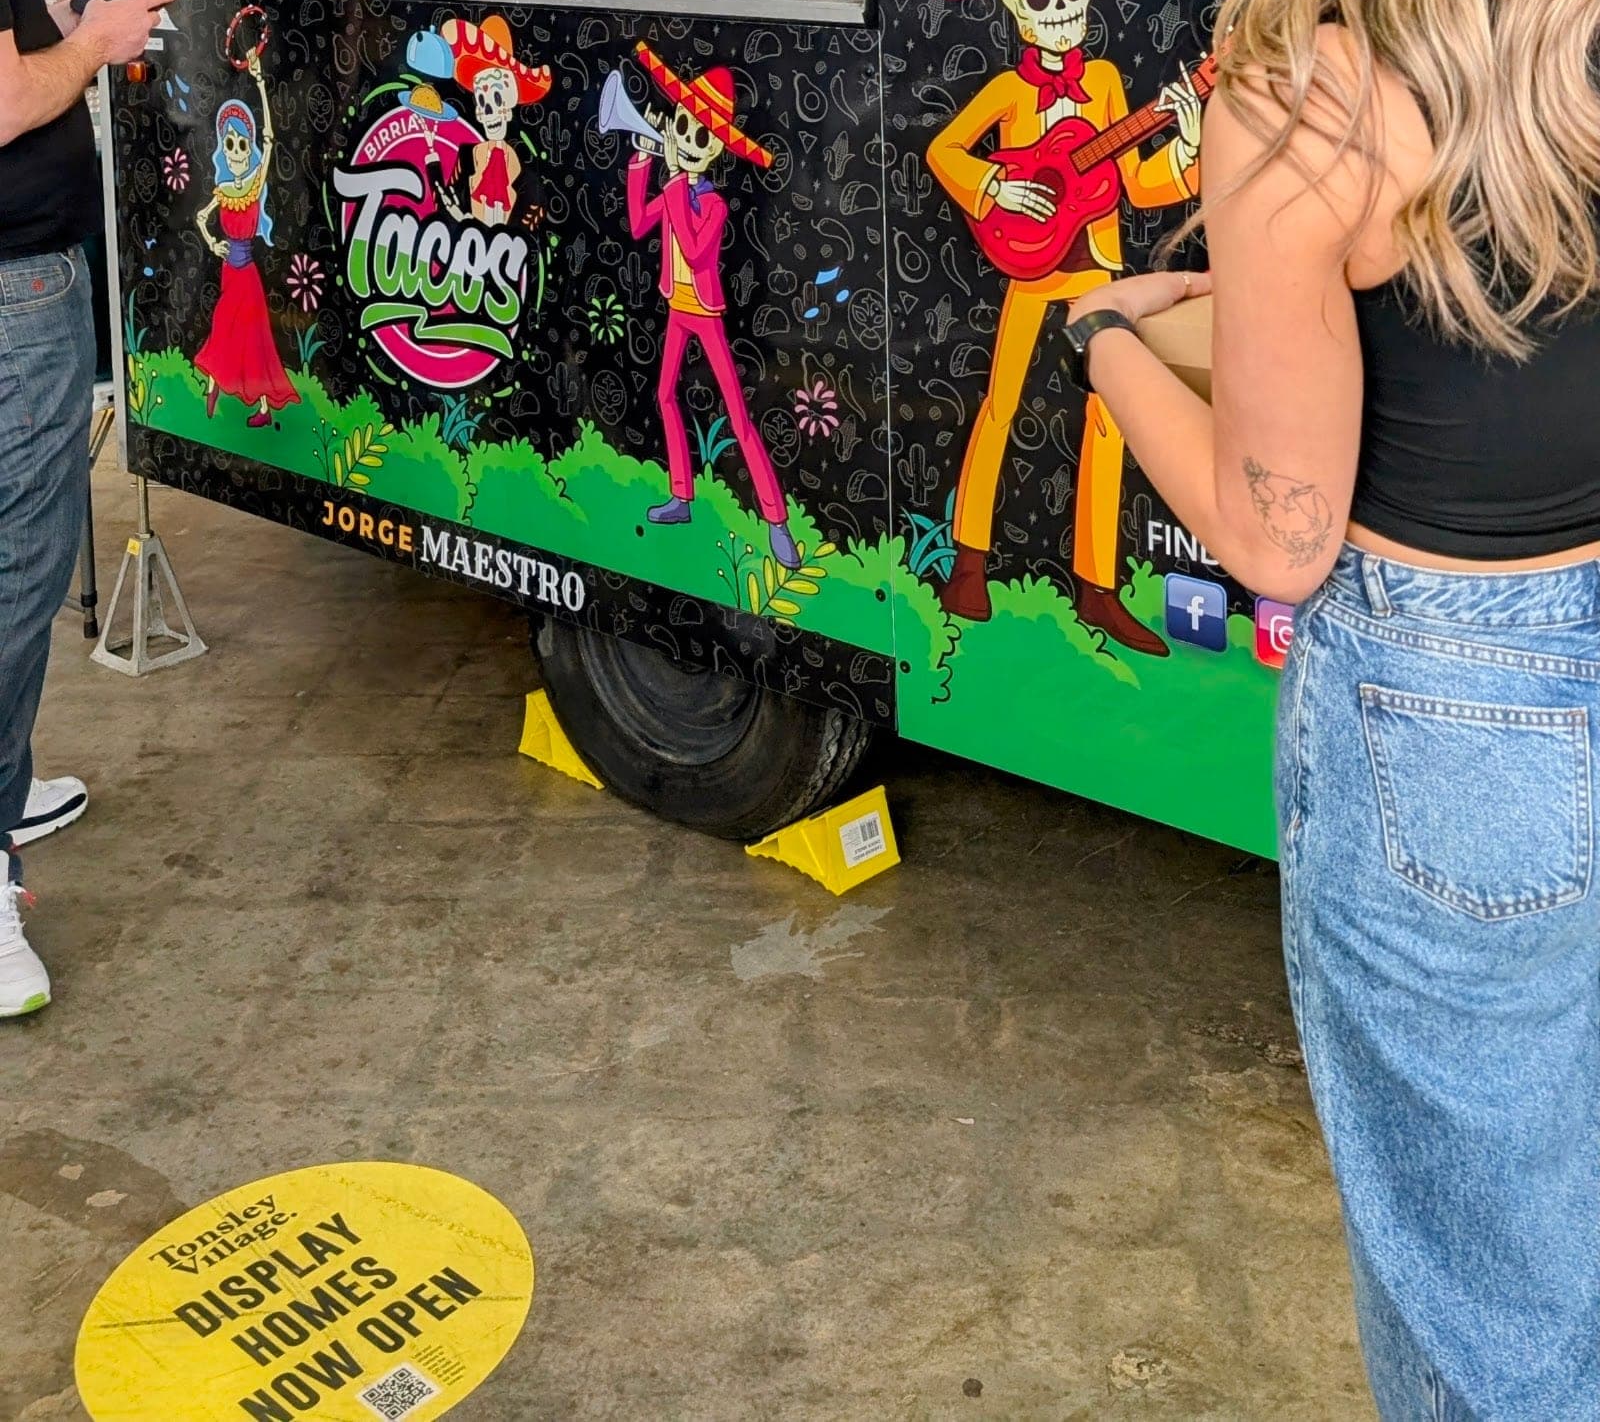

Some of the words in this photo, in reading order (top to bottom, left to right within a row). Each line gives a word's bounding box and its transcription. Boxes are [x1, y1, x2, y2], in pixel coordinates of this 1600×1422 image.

[364, 113, 420, 161] BIRRIA
[333, 166, 528, 326] Tacos
[322, 500, 413, 552] JORGE
[420, 525, 586, 612] MAESTRO
[148, 1193, 276, 1268] Tonsley
[173, 1212, 363, 1338] DISPLAY
[231, 1255, 398, 1367] HOMES
[238, 1339, 365, 1422] NOW
[356, 1267, 484, 1354] OPEN
